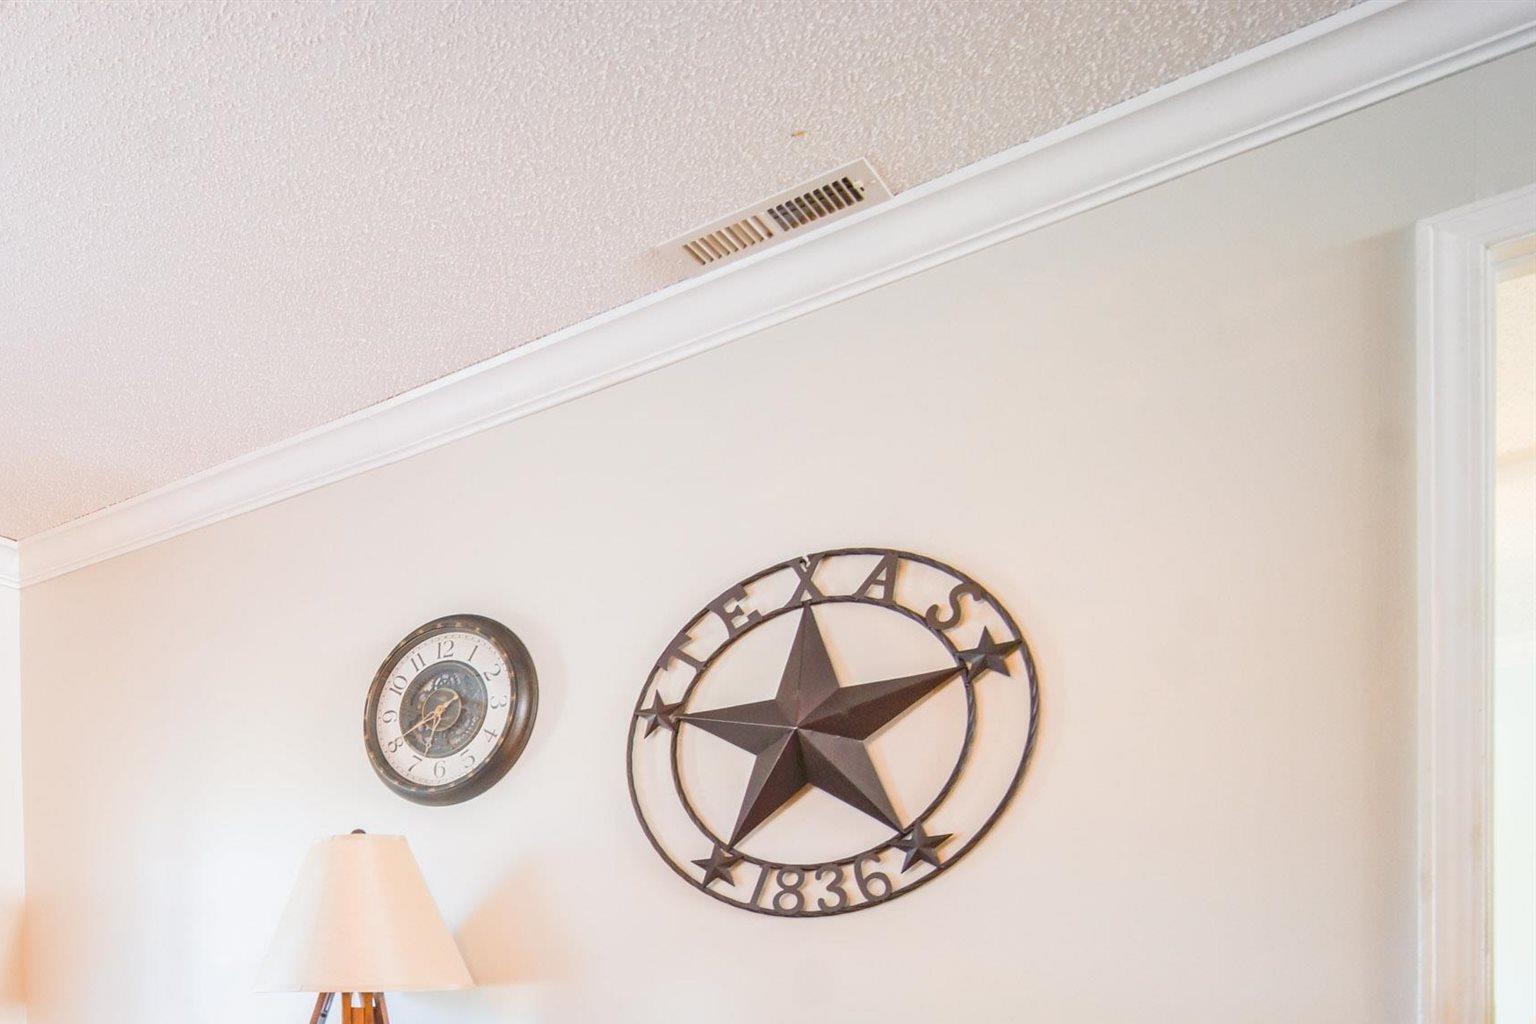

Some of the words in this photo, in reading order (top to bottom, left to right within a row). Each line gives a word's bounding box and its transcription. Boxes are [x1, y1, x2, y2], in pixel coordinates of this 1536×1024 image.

[658, 552, 984, 671] TEXAS
[435, 640, 455, 660] 12
[467, 645, 479, 662] 1
[410, 652, 427, 672] 11
[485, 663, 502, 682] 2
[389, 675, 408, 696] 10
[490, 695, 508, 711] 3
[382, 710, 398, 724] 9
[484, 727, 498, 743] 4
[387, 736, 404, 754] 8
[406, 754, 423, 773] 7
[460, 749, 476, 769] 5
[433, 760, 446, 778] 6
[749, 857, 893, 914] 1836
